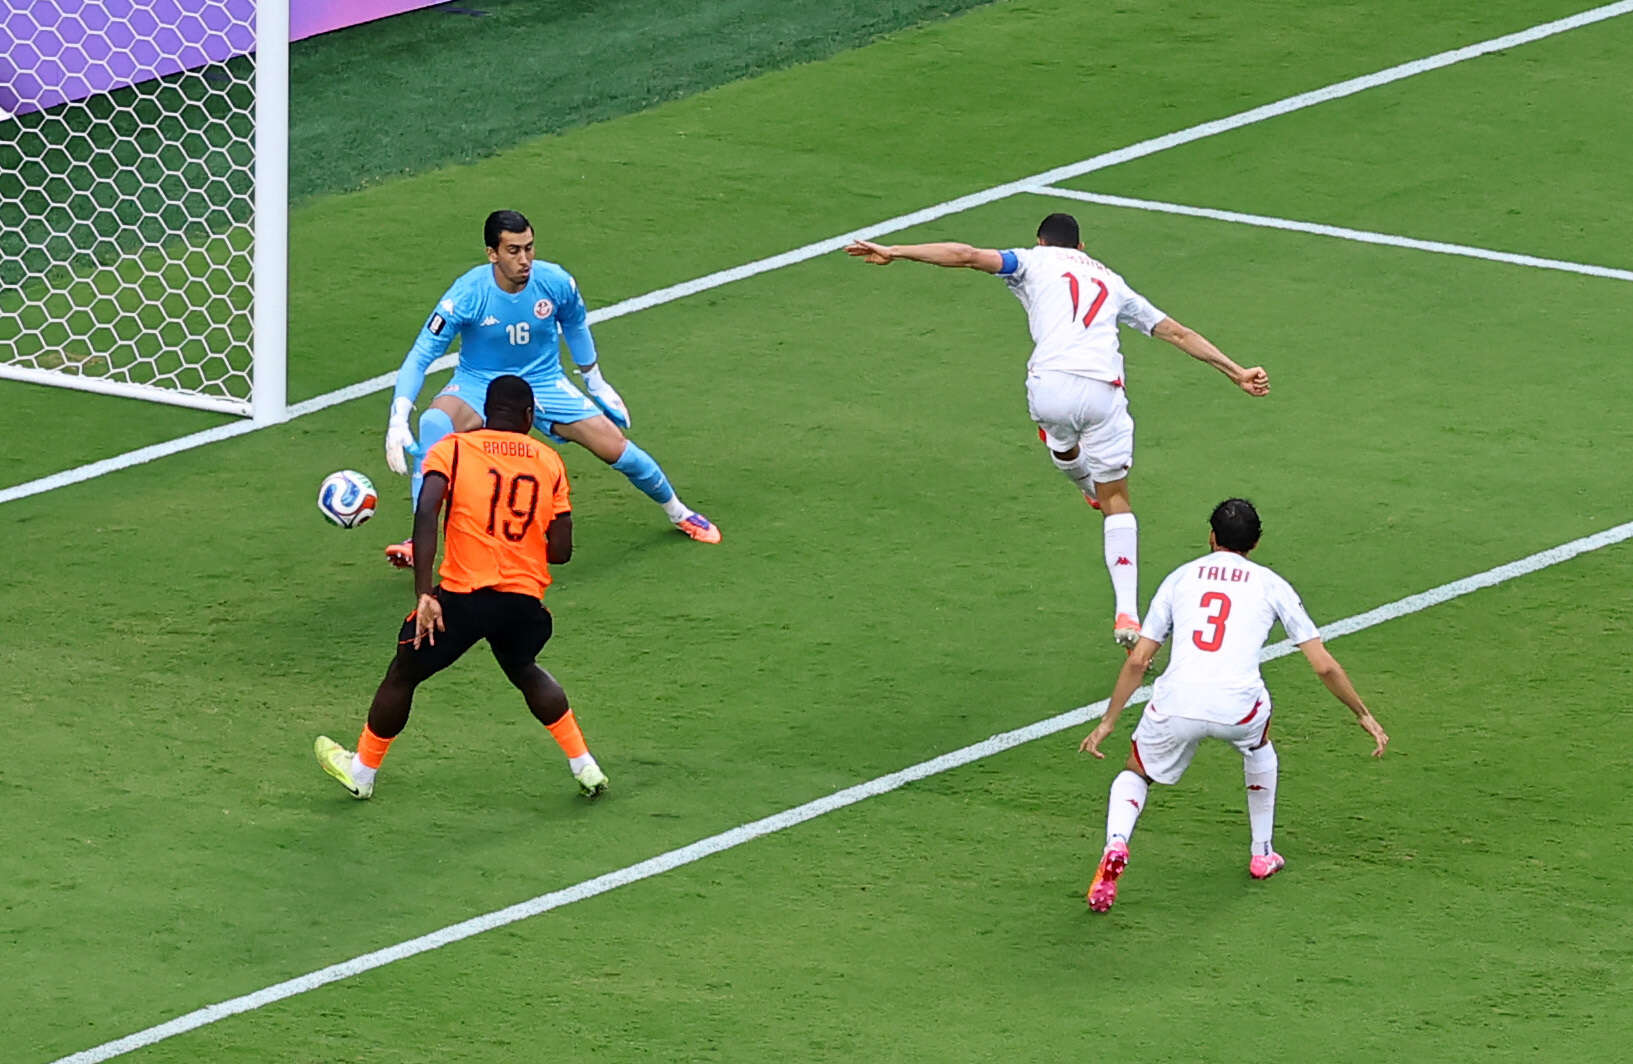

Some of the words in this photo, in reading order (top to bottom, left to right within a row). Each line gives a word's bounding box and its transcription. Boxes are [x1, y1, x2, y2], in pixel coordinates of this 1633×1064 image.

[1061, 271, 1109, 329] 17
[505, 322, 530, 345] 16
[486, 468, 539, 542] 19
[1197, 566, 1250, 583] TALBI
[1192, 591, 1232, 652] 3
